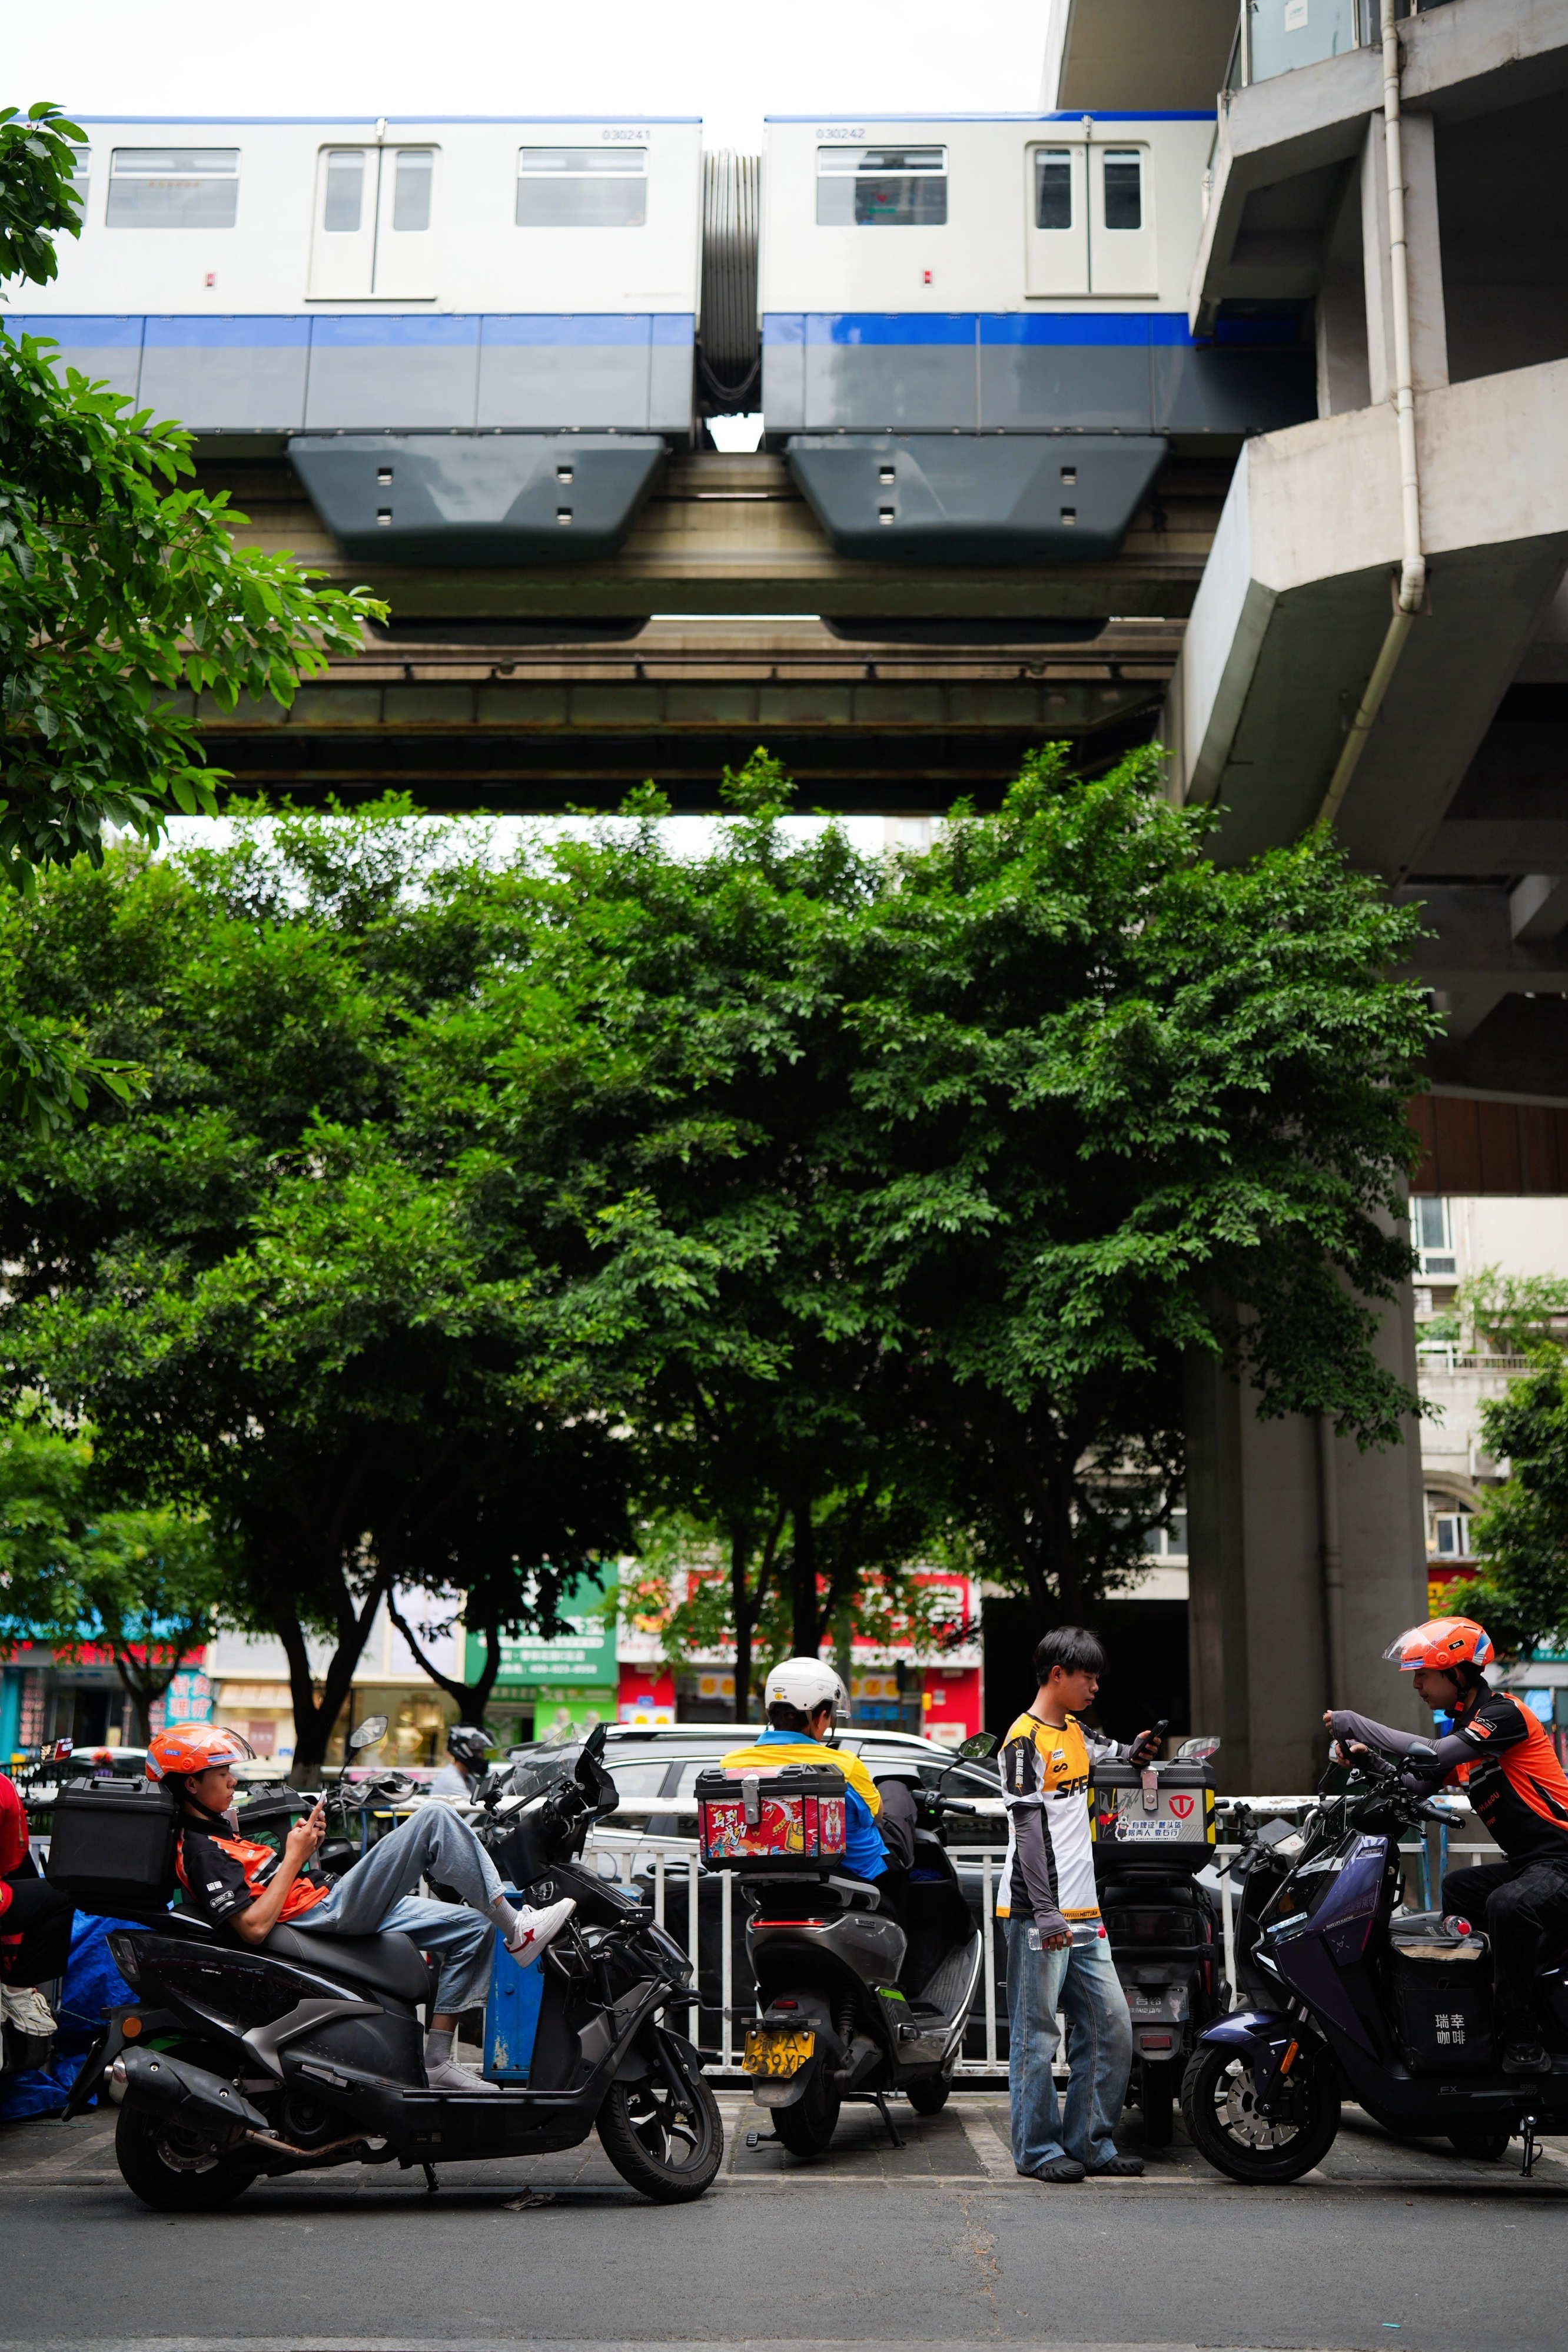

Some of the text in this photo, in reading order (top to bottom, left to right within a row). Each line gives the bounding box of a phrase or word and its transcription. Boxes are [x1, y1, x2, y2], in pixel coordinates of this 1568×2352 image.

[602, 129, 650, 140] 030241
[816, 128, 866, 139] 030242
[168, 1697, 212, 1719] 理疗
[1435, 2014, 1464, 2029] 瑞幸
[783, 2034, 798, 2052] A
[1437, 2030, 1466, 2045] 咖啡
